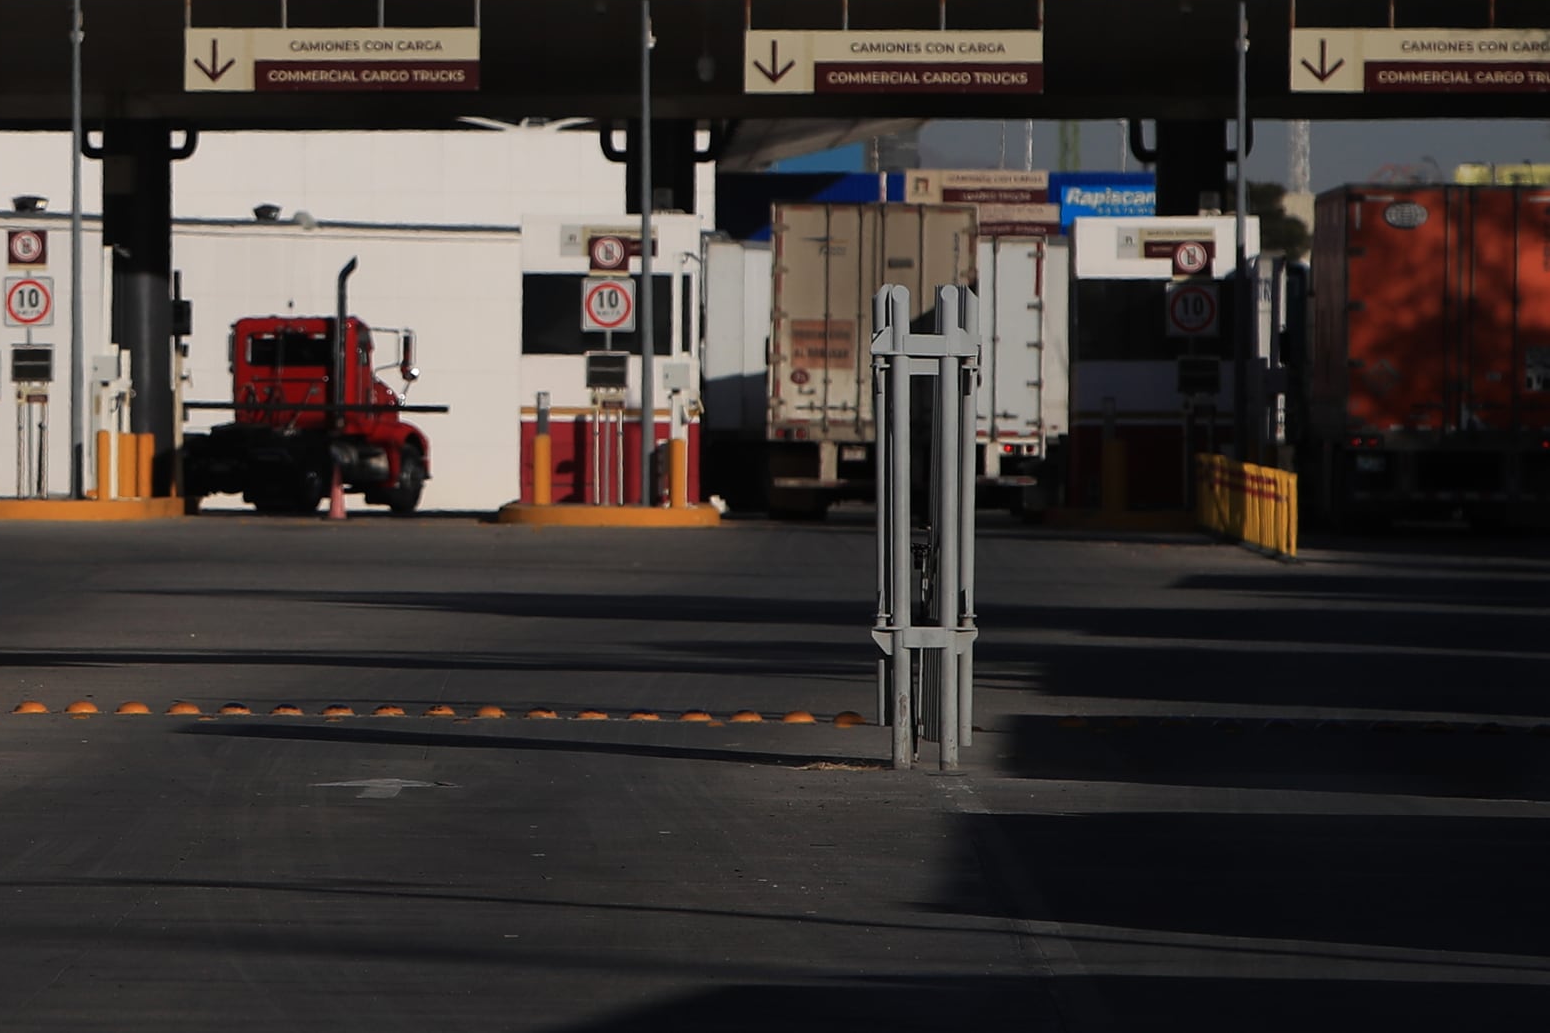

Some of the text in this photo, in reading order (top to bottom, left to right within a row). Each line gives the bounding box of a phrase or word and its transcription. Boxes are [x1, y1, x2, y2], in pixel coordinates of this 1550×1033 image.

[290, 40, 443, 52] CAMIONES CON CARGA
[850, 42, 1007, 54] CAMIONES CON CARGA
[1401, 40, 1474, 53] CAMIONES
[1478, 40, 1508, 53] CON
[267, 70, 466, 83] COMMERCIAL CARGO TRUCKS
[827, 72, 1028, 85] COMMERCIAL CARGO TRUCKS
[1377, 71, 1473, 85] COMMERCIAL
[1475, 71, 1525, 85] CARGO
[1066, 186, 1155, 208] Rapiscan
[18, 288, 39, 308] 10
[597, 289, 619, 308] 10
[1182, 296, 1204, 316] 10
